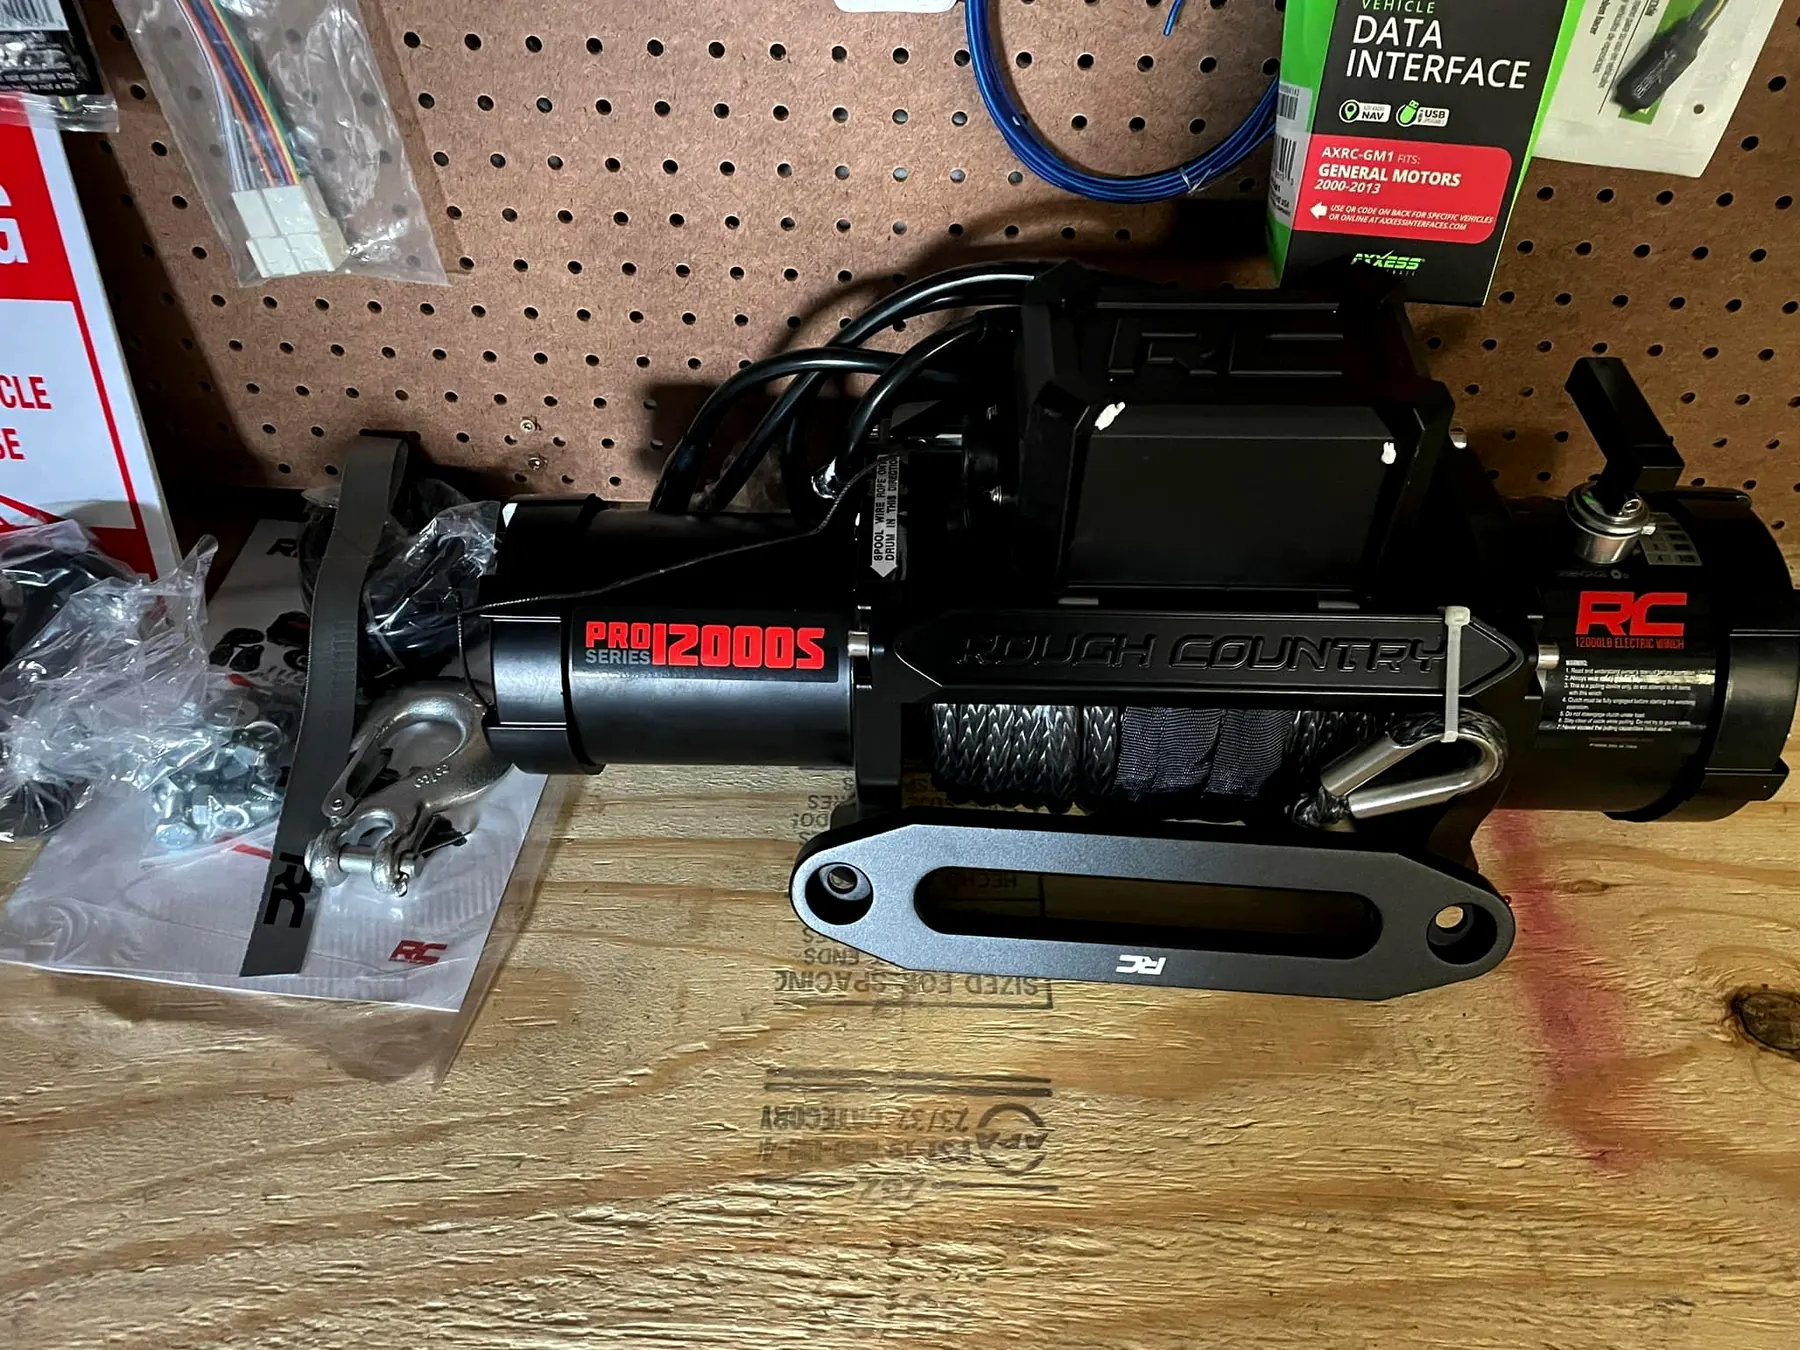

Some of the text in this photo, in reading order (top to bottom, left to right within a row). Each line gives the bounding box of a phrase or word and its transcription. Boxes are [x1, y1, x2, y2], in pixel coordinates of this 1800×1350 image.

[1362, 0, 1435, 14] VEHICLE
[1352, 14, 1443, 50] DATA
[1346, 48, 1531, 89] INTERFACE
[1361, 110, 1385, 121] NAV
[1424, 109, 1446, 120] USB
[1322, 146, 1394, 163] AXRC-GM1
[1318, 163, 1462, 187] GENERAL MOTORS
[1314, 178, 1381, 194] 2000-2013
[1328, 213, 1467, 231] OR ONLINE AT AXXESSINTERFACES.COM
[1330, 204, 1495, 224] USE QR CODE ON BACK FOR SPECIFIC VEHICLES
[1350, 249, 1426, 271] AXXESS
[876, 477, 886, 498] ROPE
[875, 501, 885, 525] WIRE
[887, 495, 897, 514] THIS
[885, 517, 896, 528] IN
[873, 529, 885, 561] SPOOL
[884, 534, 895, 561] DRUM
[1575, 590, 1688, 637] RC
[585, 621, 825, 670] PRO 12000S
[956, 632, 1446, 673] ROUGH COUNTRY
[1575, 636, 1613, 648] 12000LB
[1614, 637, 1655, 649] ELECTRIC
[585, 649, 650, 665] SERIES
[388, 939, 448, 965] RC
[803, 948, 861, 966] ENDS
[1115, 954, 1167, 975] RC
[774, 969, 1040, 996] SIZED FOR SPACING
[975, 1130, 1049, 1151] APA
